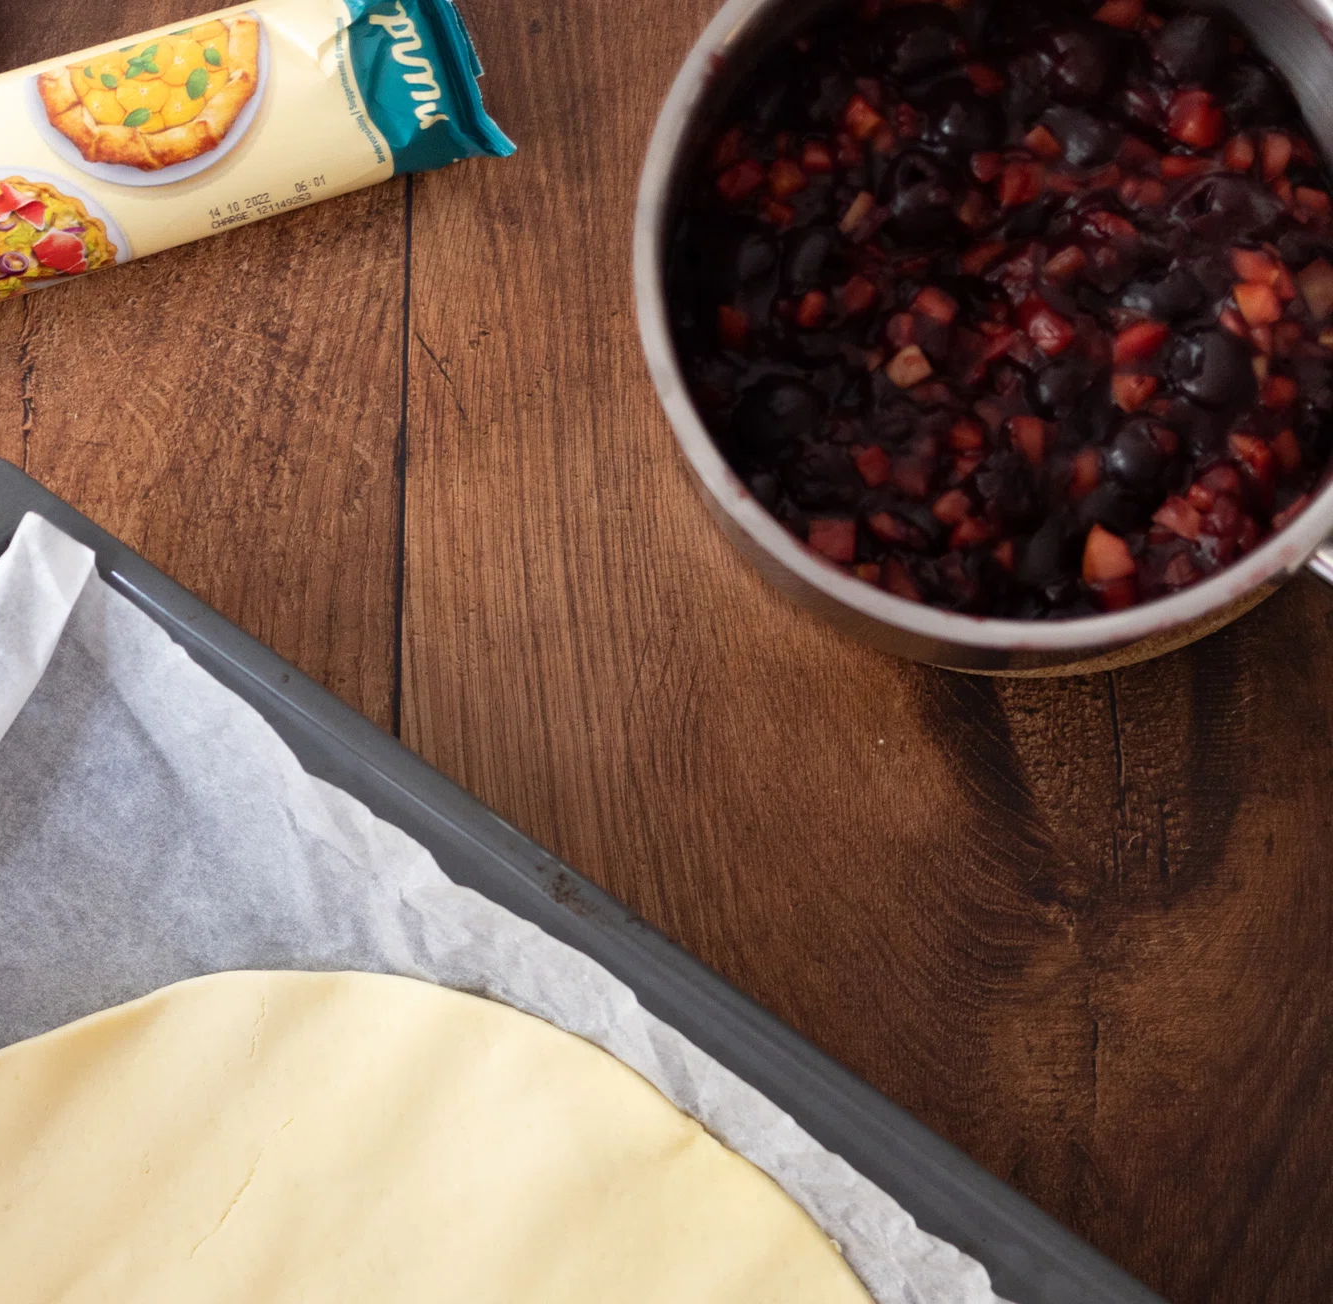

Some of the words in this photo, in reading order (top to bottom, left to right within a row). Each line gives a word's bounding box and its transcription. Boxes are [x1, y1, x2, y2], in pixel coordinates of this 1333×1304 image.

[369, 0, 450, 130] rund
[209, 207, 221, 219] 14
[227, 201, 240, 213] 10
[244, 192, 271, 209] 2022
